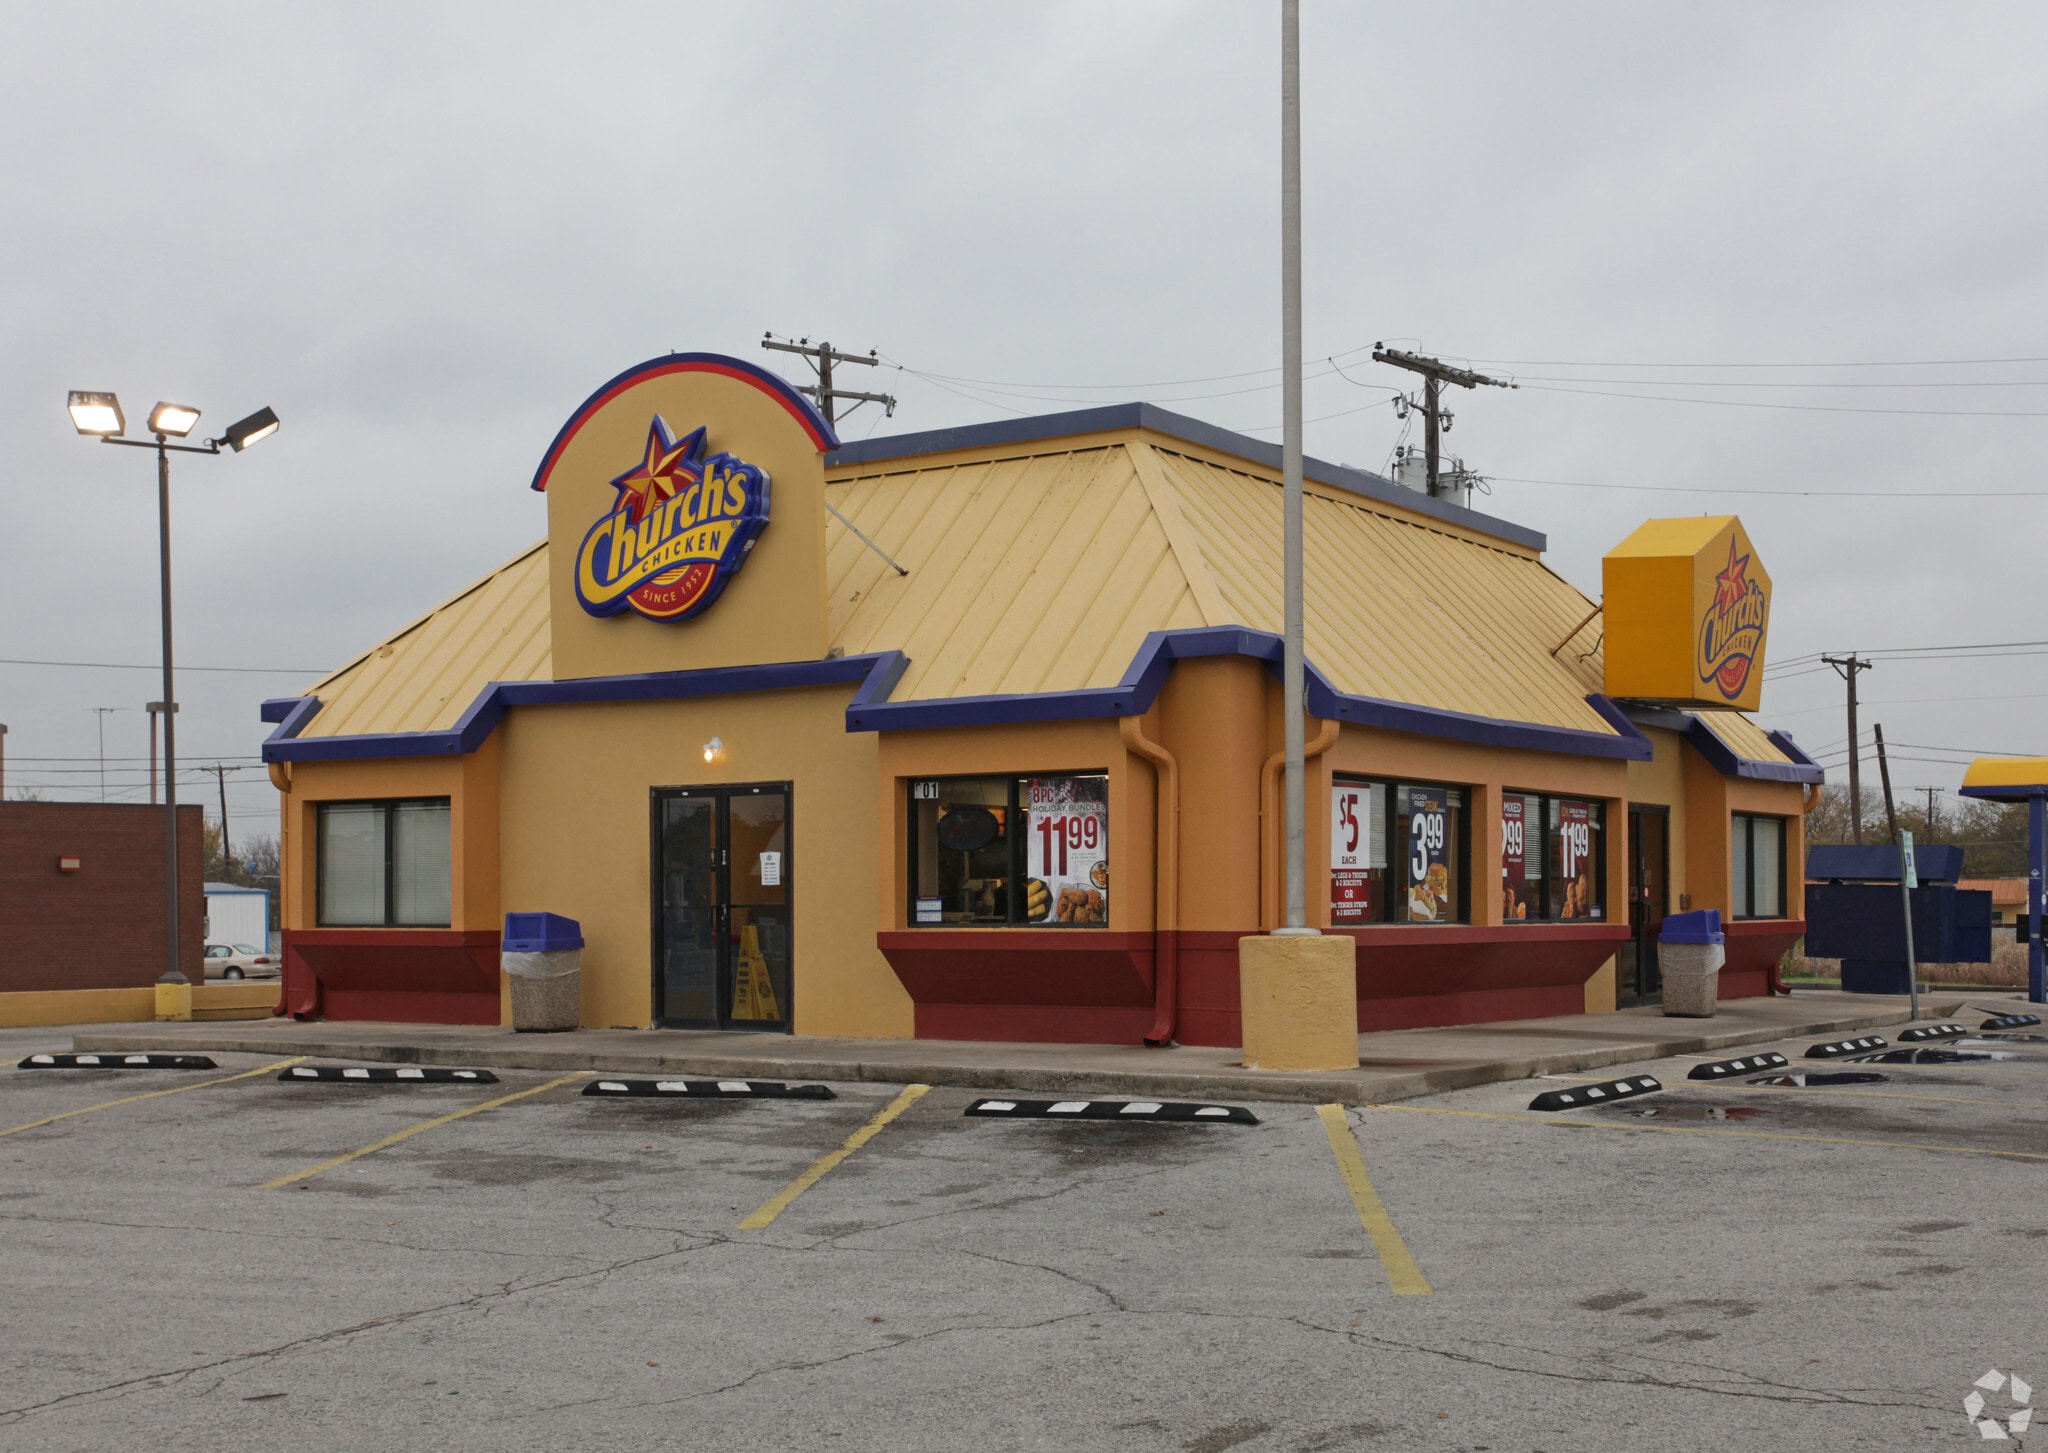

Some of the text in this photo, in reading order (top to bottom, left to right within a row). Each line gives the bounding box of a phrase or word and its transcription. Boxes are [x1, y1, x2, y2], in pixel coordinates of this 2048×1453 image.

[578, 463, 748, 604] Church's
[642, 530, 721, 573] CHICKEN
[642, 568, 703, 604] SINCE 1952
[1699, 582, 1764, 679] Church's
[1722, 634, 1753, 657] CHICKEN
[1032, 803, 1101, 813] HOLIDAY BUNDLE
[1504, 802, 1521, 812] MIXED
[1339, 794, 1359, 853] $5
[1341, 856, 1357, 865] EACH
[1344, 889, 1354, 899] OR
